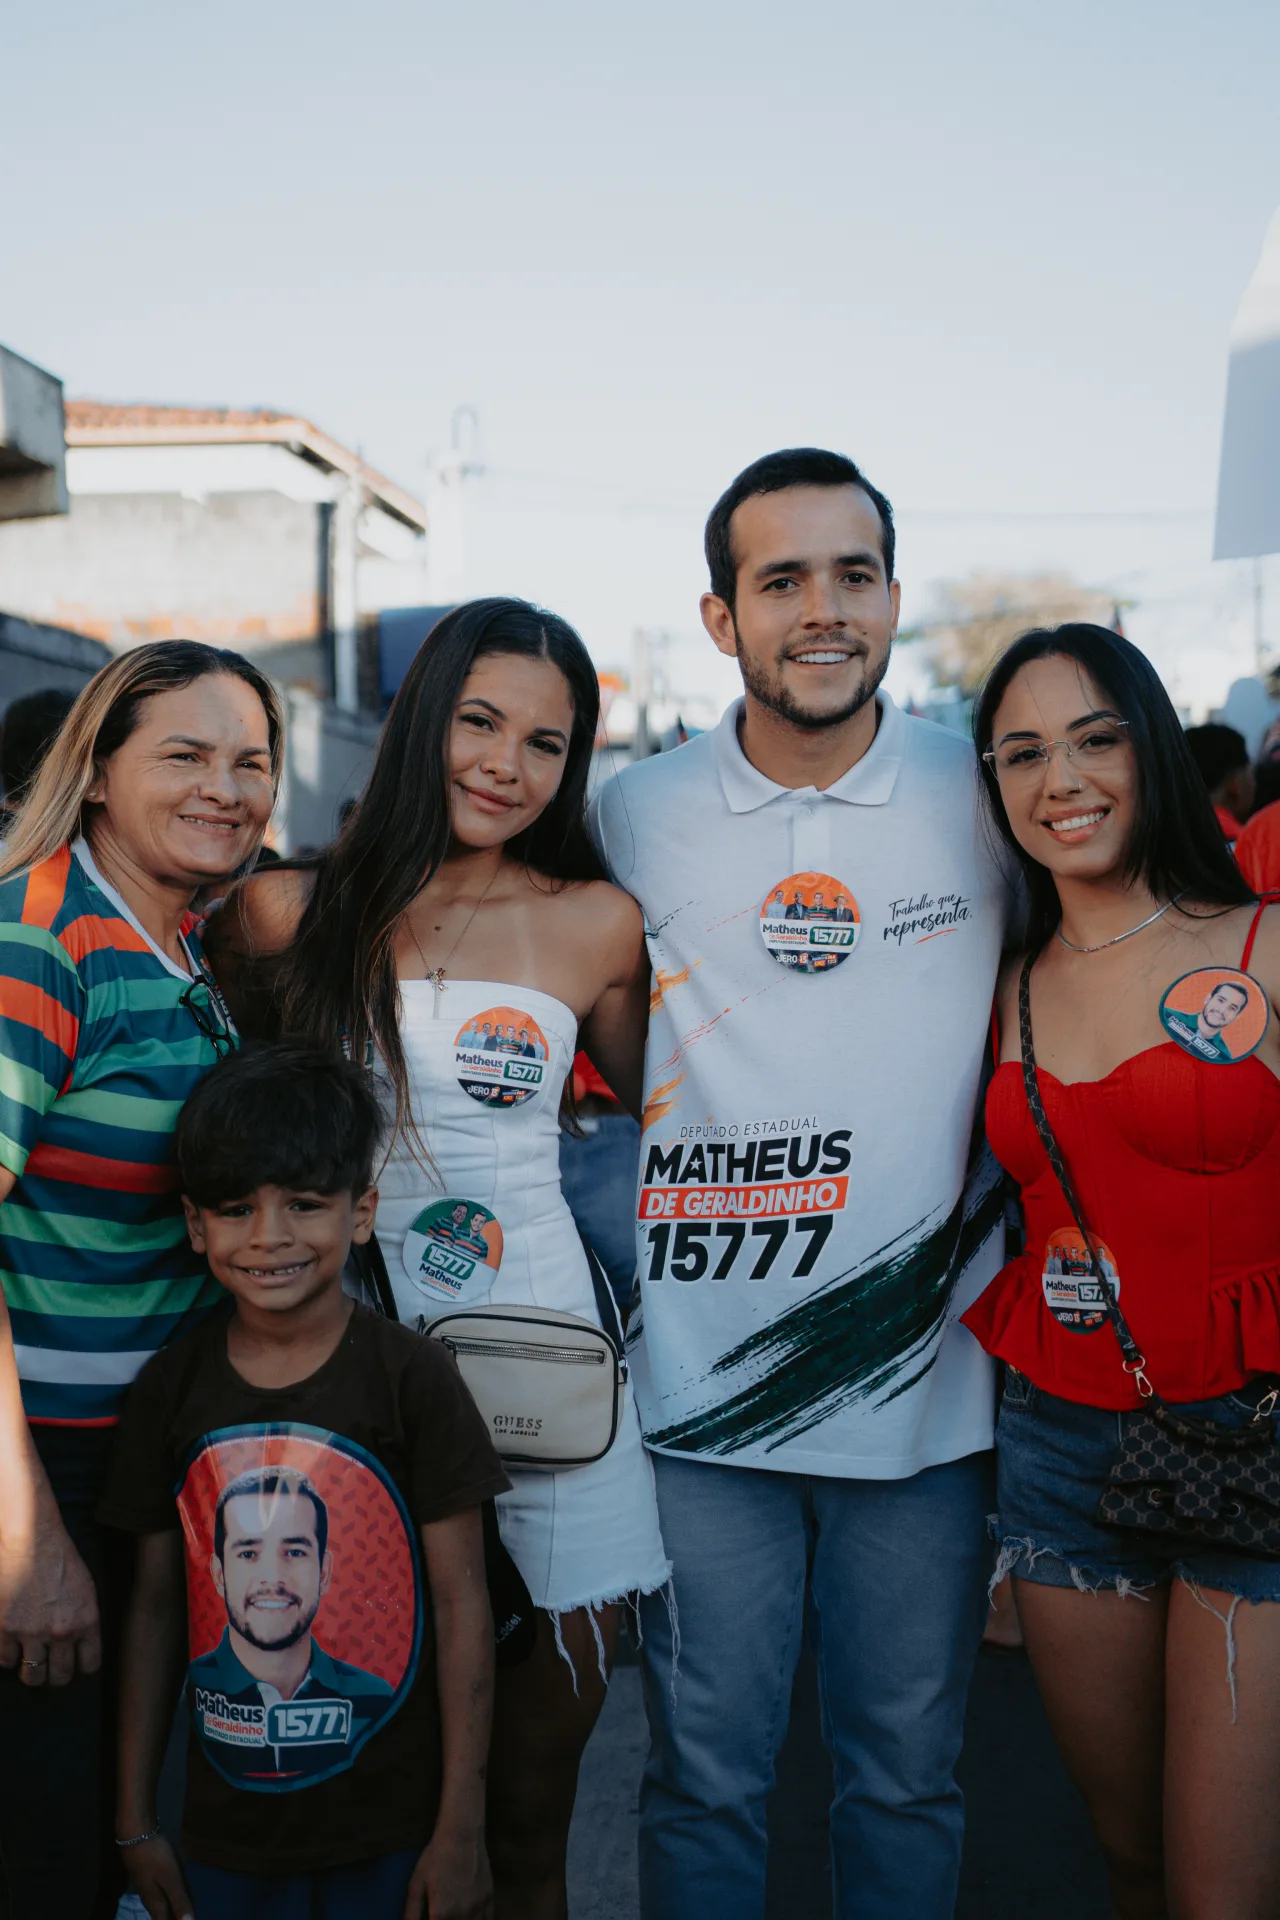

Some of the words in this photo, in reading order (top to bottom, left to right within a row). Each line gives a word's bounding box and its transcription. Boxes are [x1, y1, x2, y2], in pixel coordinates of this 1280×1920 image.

[888, 893, 935, 921] Trabalho
[938, 894, 956, 910] que
[762, 924, 808, 935] Matheus
[813, 928, 851, 944] 15777
[456, 1053, 503, 1068] Matheus
[680, 1125, 739, 1138] DEPUTADO
[744, 1116, 818, 1136] ESTADUAL
[644, 1130, 853, 1184] MATHEUS
[646, 1192, 678, 1216] DE
[683, 1182, 838, 1216] GERALDINHO
[648, 1214, 834, 1282] 15777
[427, 1244, 472, 1276] 15777
[419, 1263, 462, 1290] Matheus
[1046, 1280, 1077, 1291] Matheus
[494, 1415, 542, 1430] GUESS
[196, 1690, 263, 1723] Matheus
[205, 1714, 212, 1724] de
[212, 1717, 263, 1735] Geraldinho
[205, 1726, 228, 1740] DEPUTADO
[229, 1734, 263, 1744] ESTADUAL
